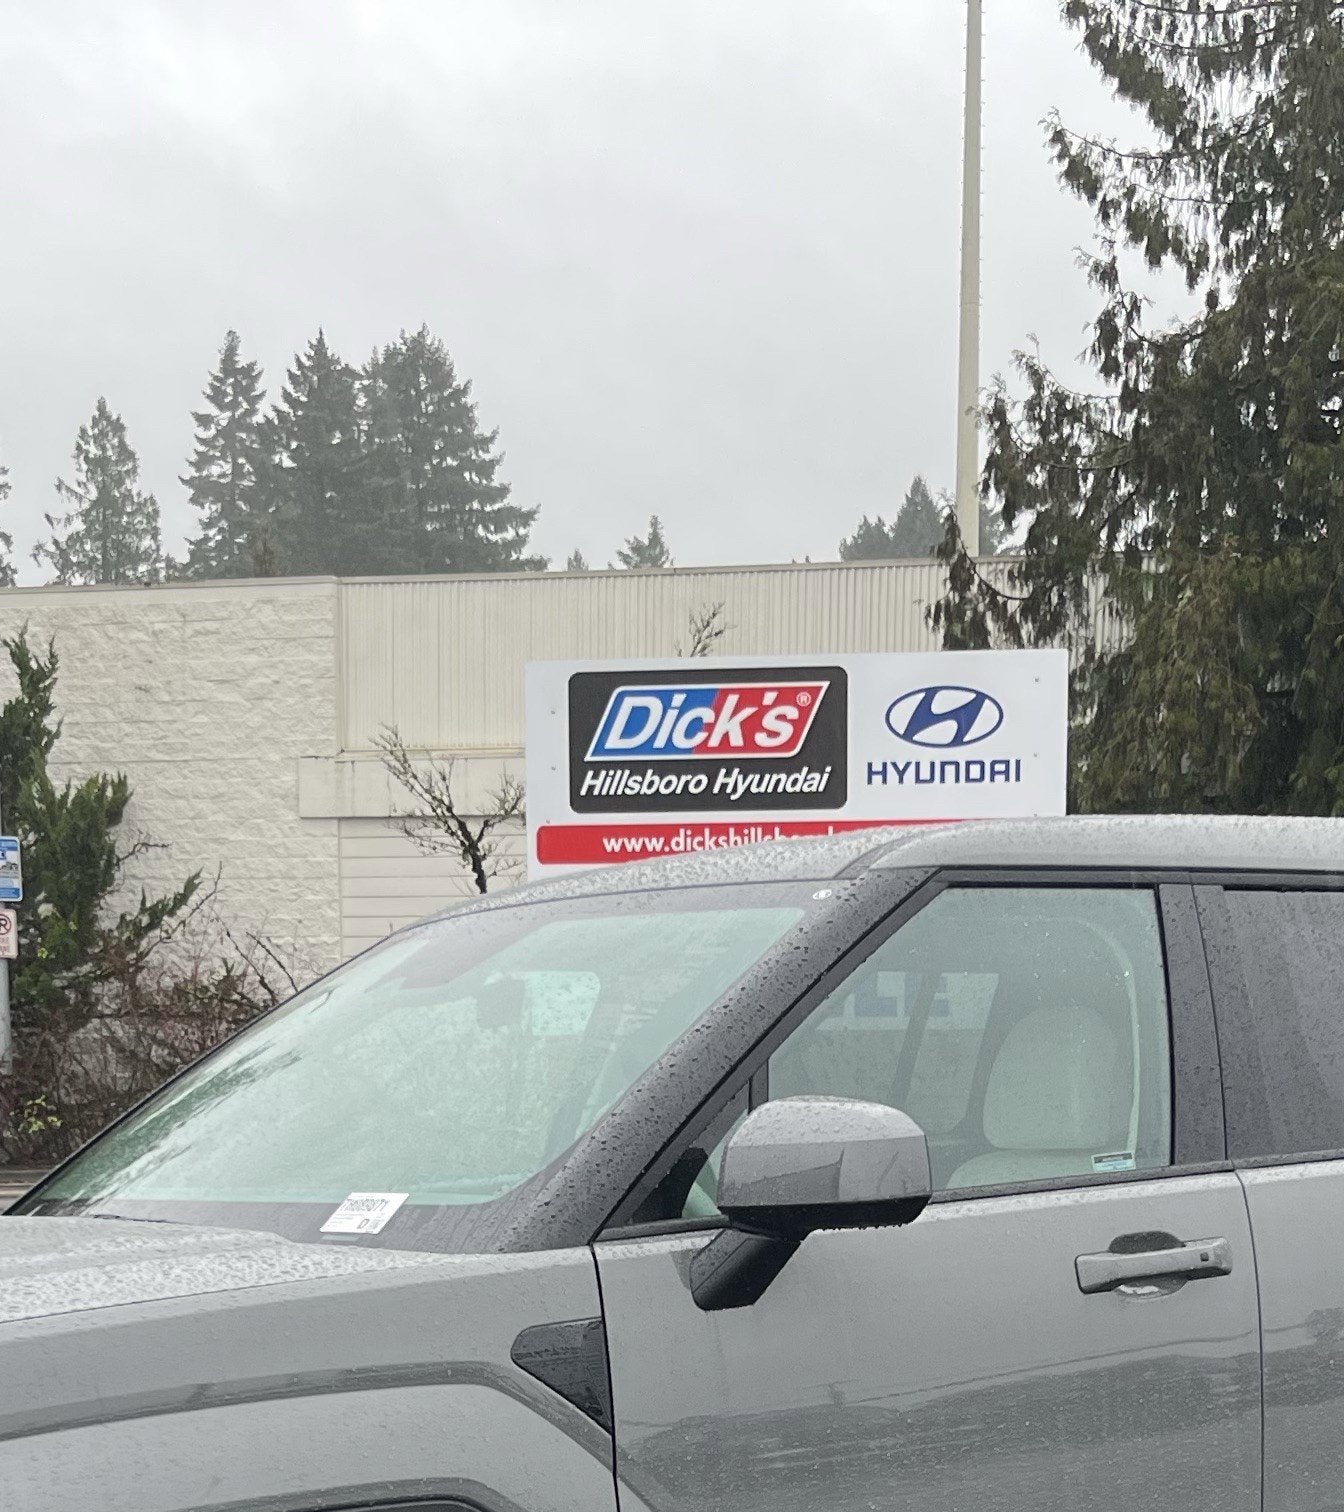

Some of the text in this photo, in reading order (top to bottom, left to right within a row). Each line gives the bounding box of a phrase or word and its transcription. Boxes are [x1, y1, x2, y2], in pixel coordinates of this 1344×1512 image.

[603, 690, 797, 750] Dick's
[580, 765, 831, 801] Hillsboro Hyundai
[866, 758, 1022, 786] HYUNDAI
